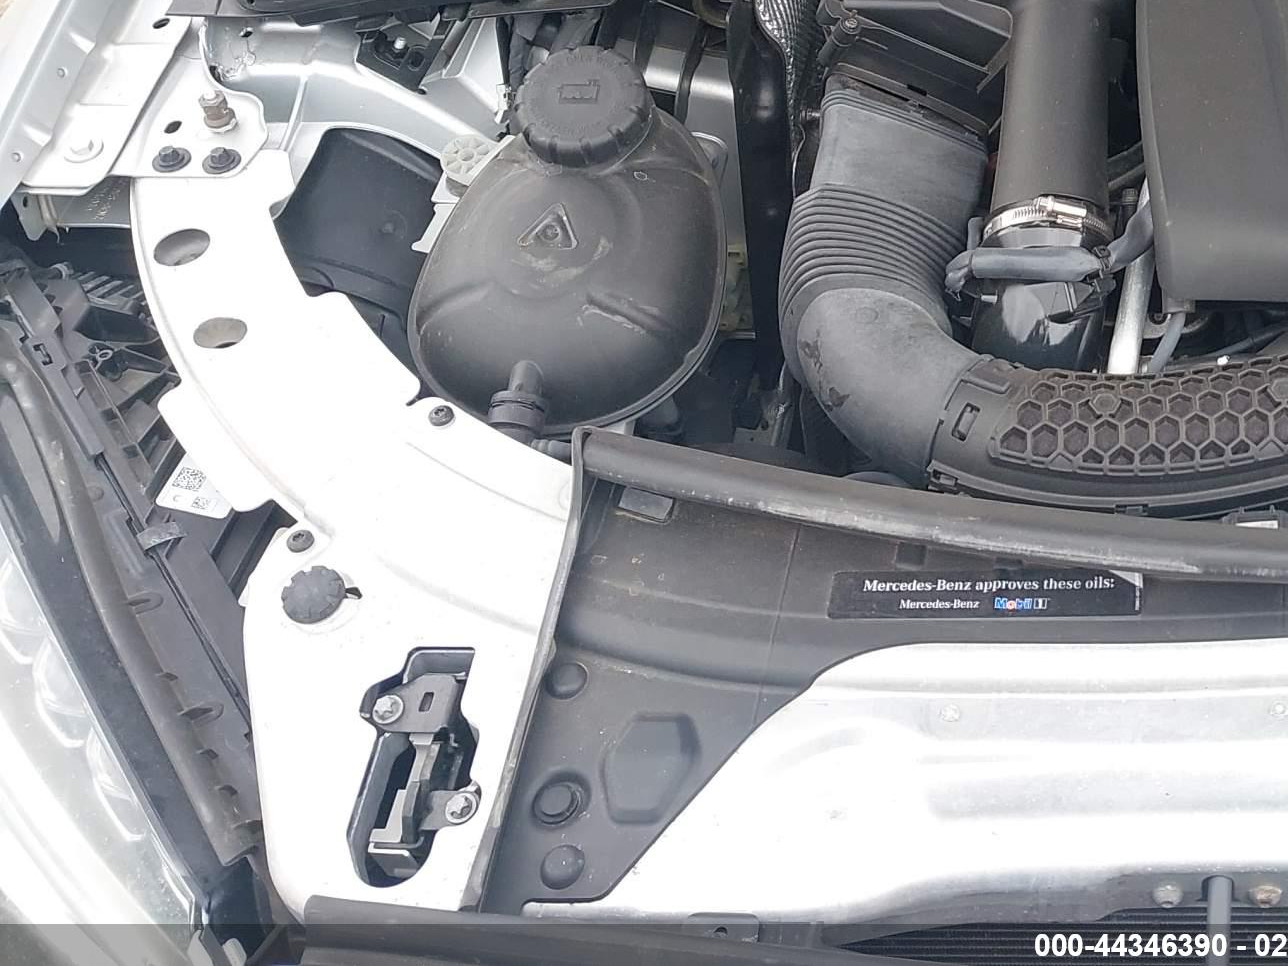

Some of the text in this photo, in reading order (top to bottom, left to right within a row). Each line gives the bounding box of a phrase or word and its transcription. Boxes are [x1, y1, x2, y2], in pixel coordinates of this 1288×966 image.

[862, 576, 1115, 593] Mercedes-Benz approves these oils:
[899, 598, 980, 609] Mercedes-Benz
[994, 597, 1032, 610] Mobil
